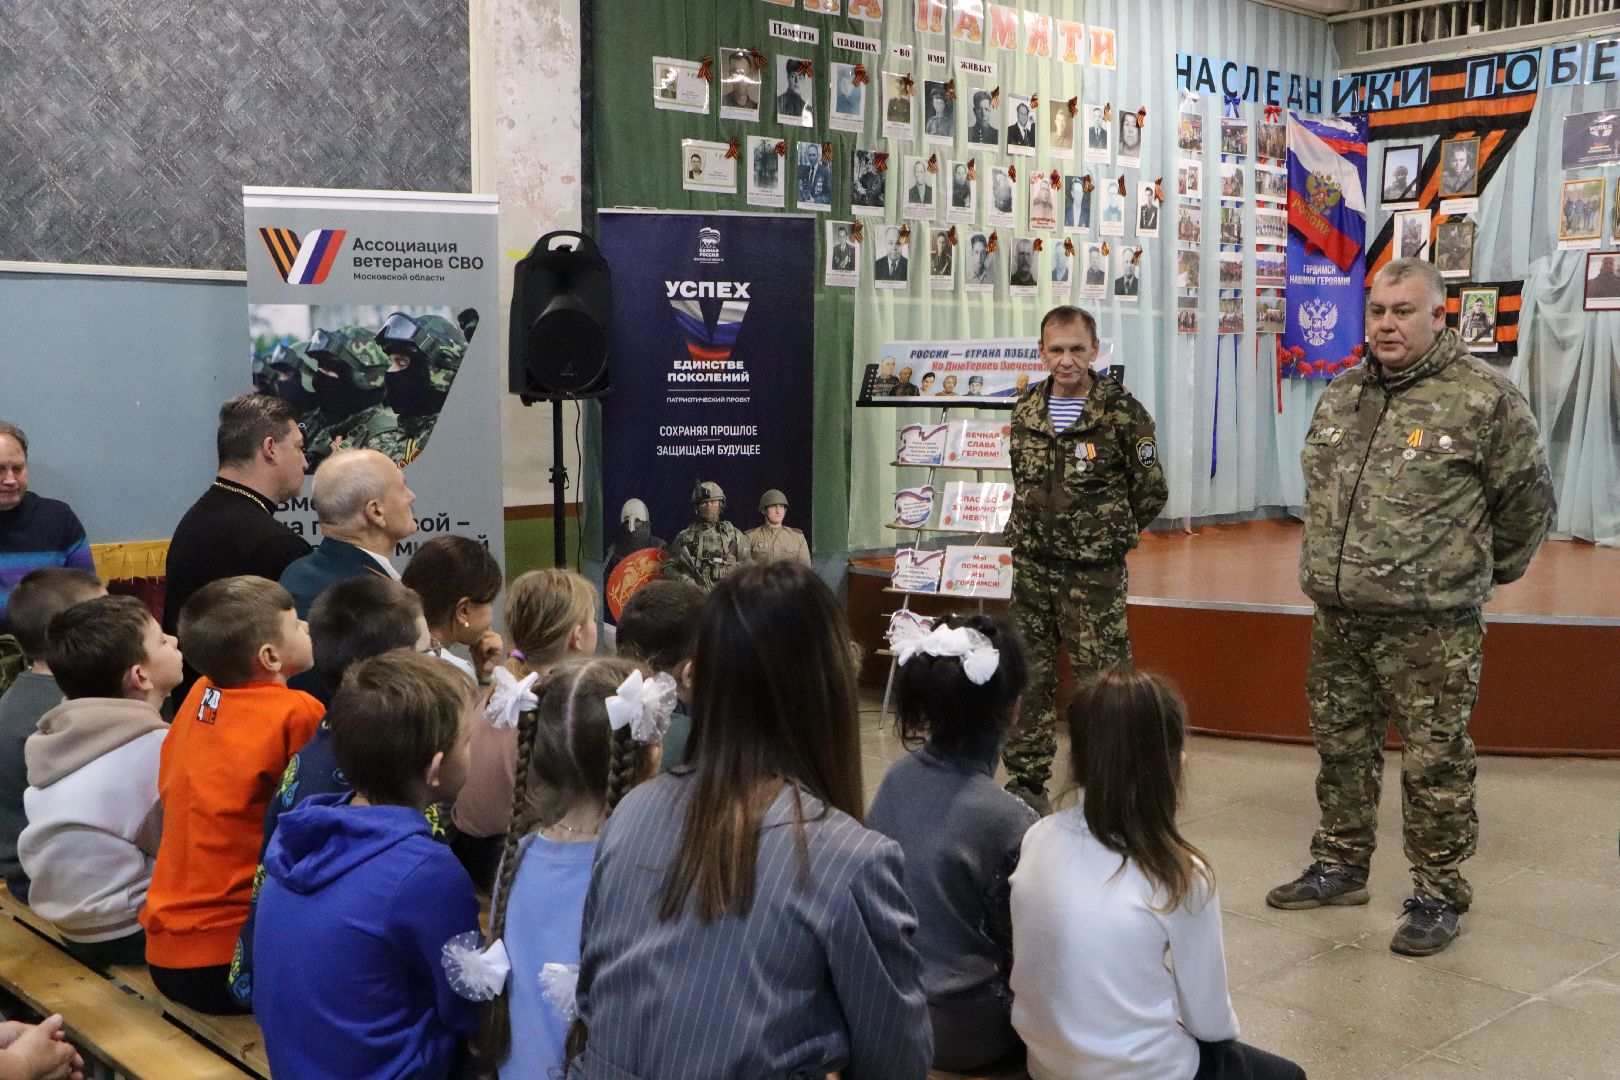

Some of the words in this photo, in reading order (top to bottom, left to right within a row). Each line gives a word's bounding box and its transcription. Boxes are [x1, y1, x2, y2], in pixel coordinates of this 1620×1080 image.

[773, 23, 815, 41] Памяти
[837, 38, 877, 52] павших
[899, 48, 910, 58] во
[928, 54, 945, 64] имя
[960, 61, 992, 74] живых
[1176, 53, 1430, 113] НАСЛЕДНИКИ
[352, 237, 458, 254] Ассоциация
[353, 256, 444, 271] ветеранов
[448, 256, 484, 270] СВО
[1303, 264, 1336, 275] ГОРДИМСЯ
[353, 272, 408, 280] Московской
[410, 273, 445, 282] области
[665, 280, 750, 298] УСПЕХ
[910, 350, 949, 359] РОССИЯ
[965, 349, 1001, 359] СТРАНА
[1004, 348, 1041, 359] ПОБЕД
[673, 360, 744, 370] ЕДИНСТВЕ
[667, 372, 750, 382] ПОКОЛЕНИЙ
[660, 425, 708, 436] СОХРАНЯЯ
[710, 425, 758, 436] ПРОШЛОЕ
[656, 445, 715, 457] ЗАЩИЩАЕМ
[717, 444, 761, 456] БУДУЩЕЕ
